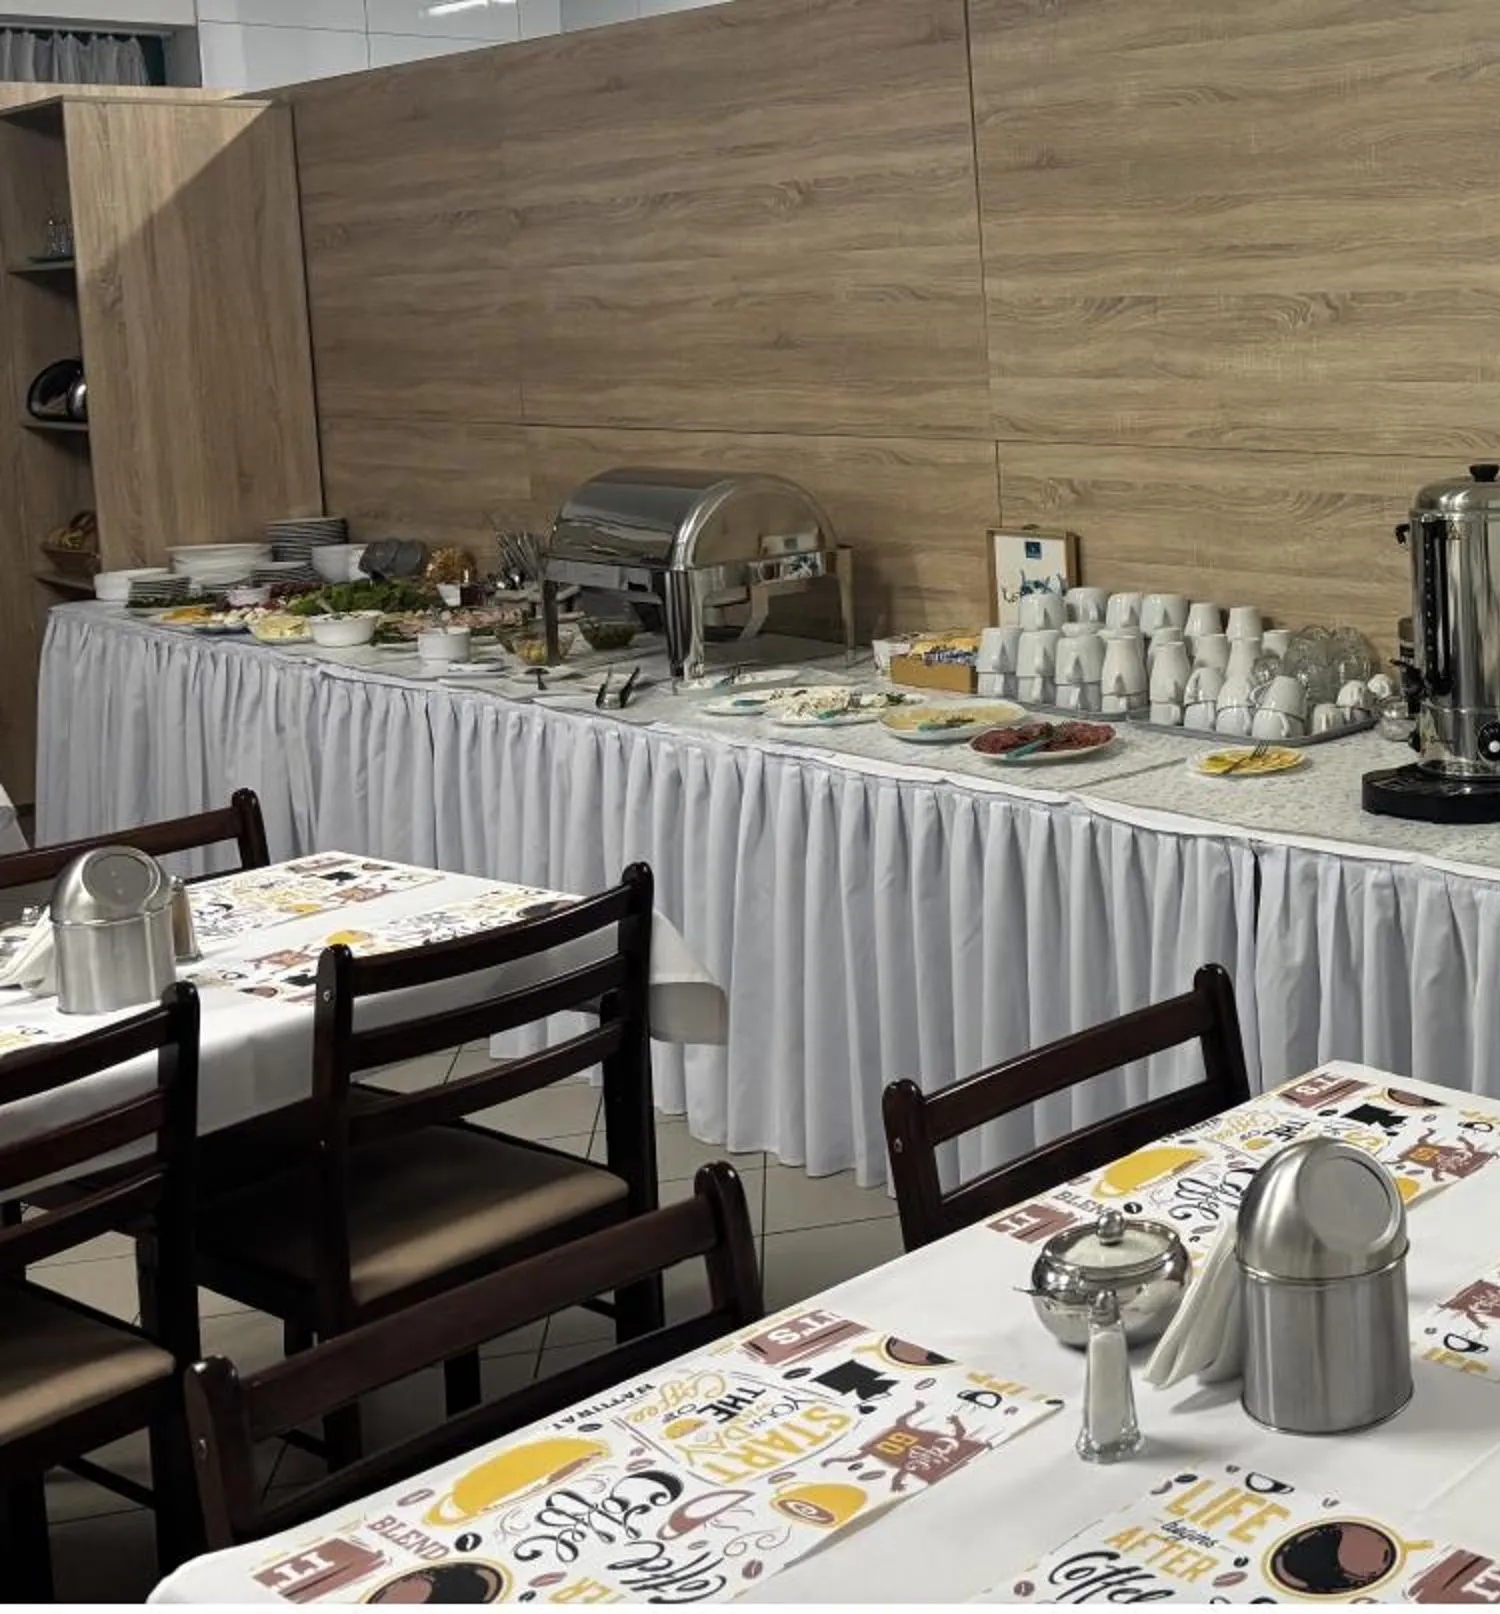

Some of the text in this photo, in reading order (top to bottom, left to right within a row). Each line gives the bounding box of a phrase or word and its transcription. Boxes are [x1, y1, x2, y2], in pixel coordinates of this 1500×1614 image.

[696, 1386, 767, 1424] THE
[703, 1407, 853, 1484] START
[366, 1514, 451, 1560] BLEND
[1164, 1479, 1292, 1544] LIFE
[1104, 1525, 1219, 1582] AFTER
